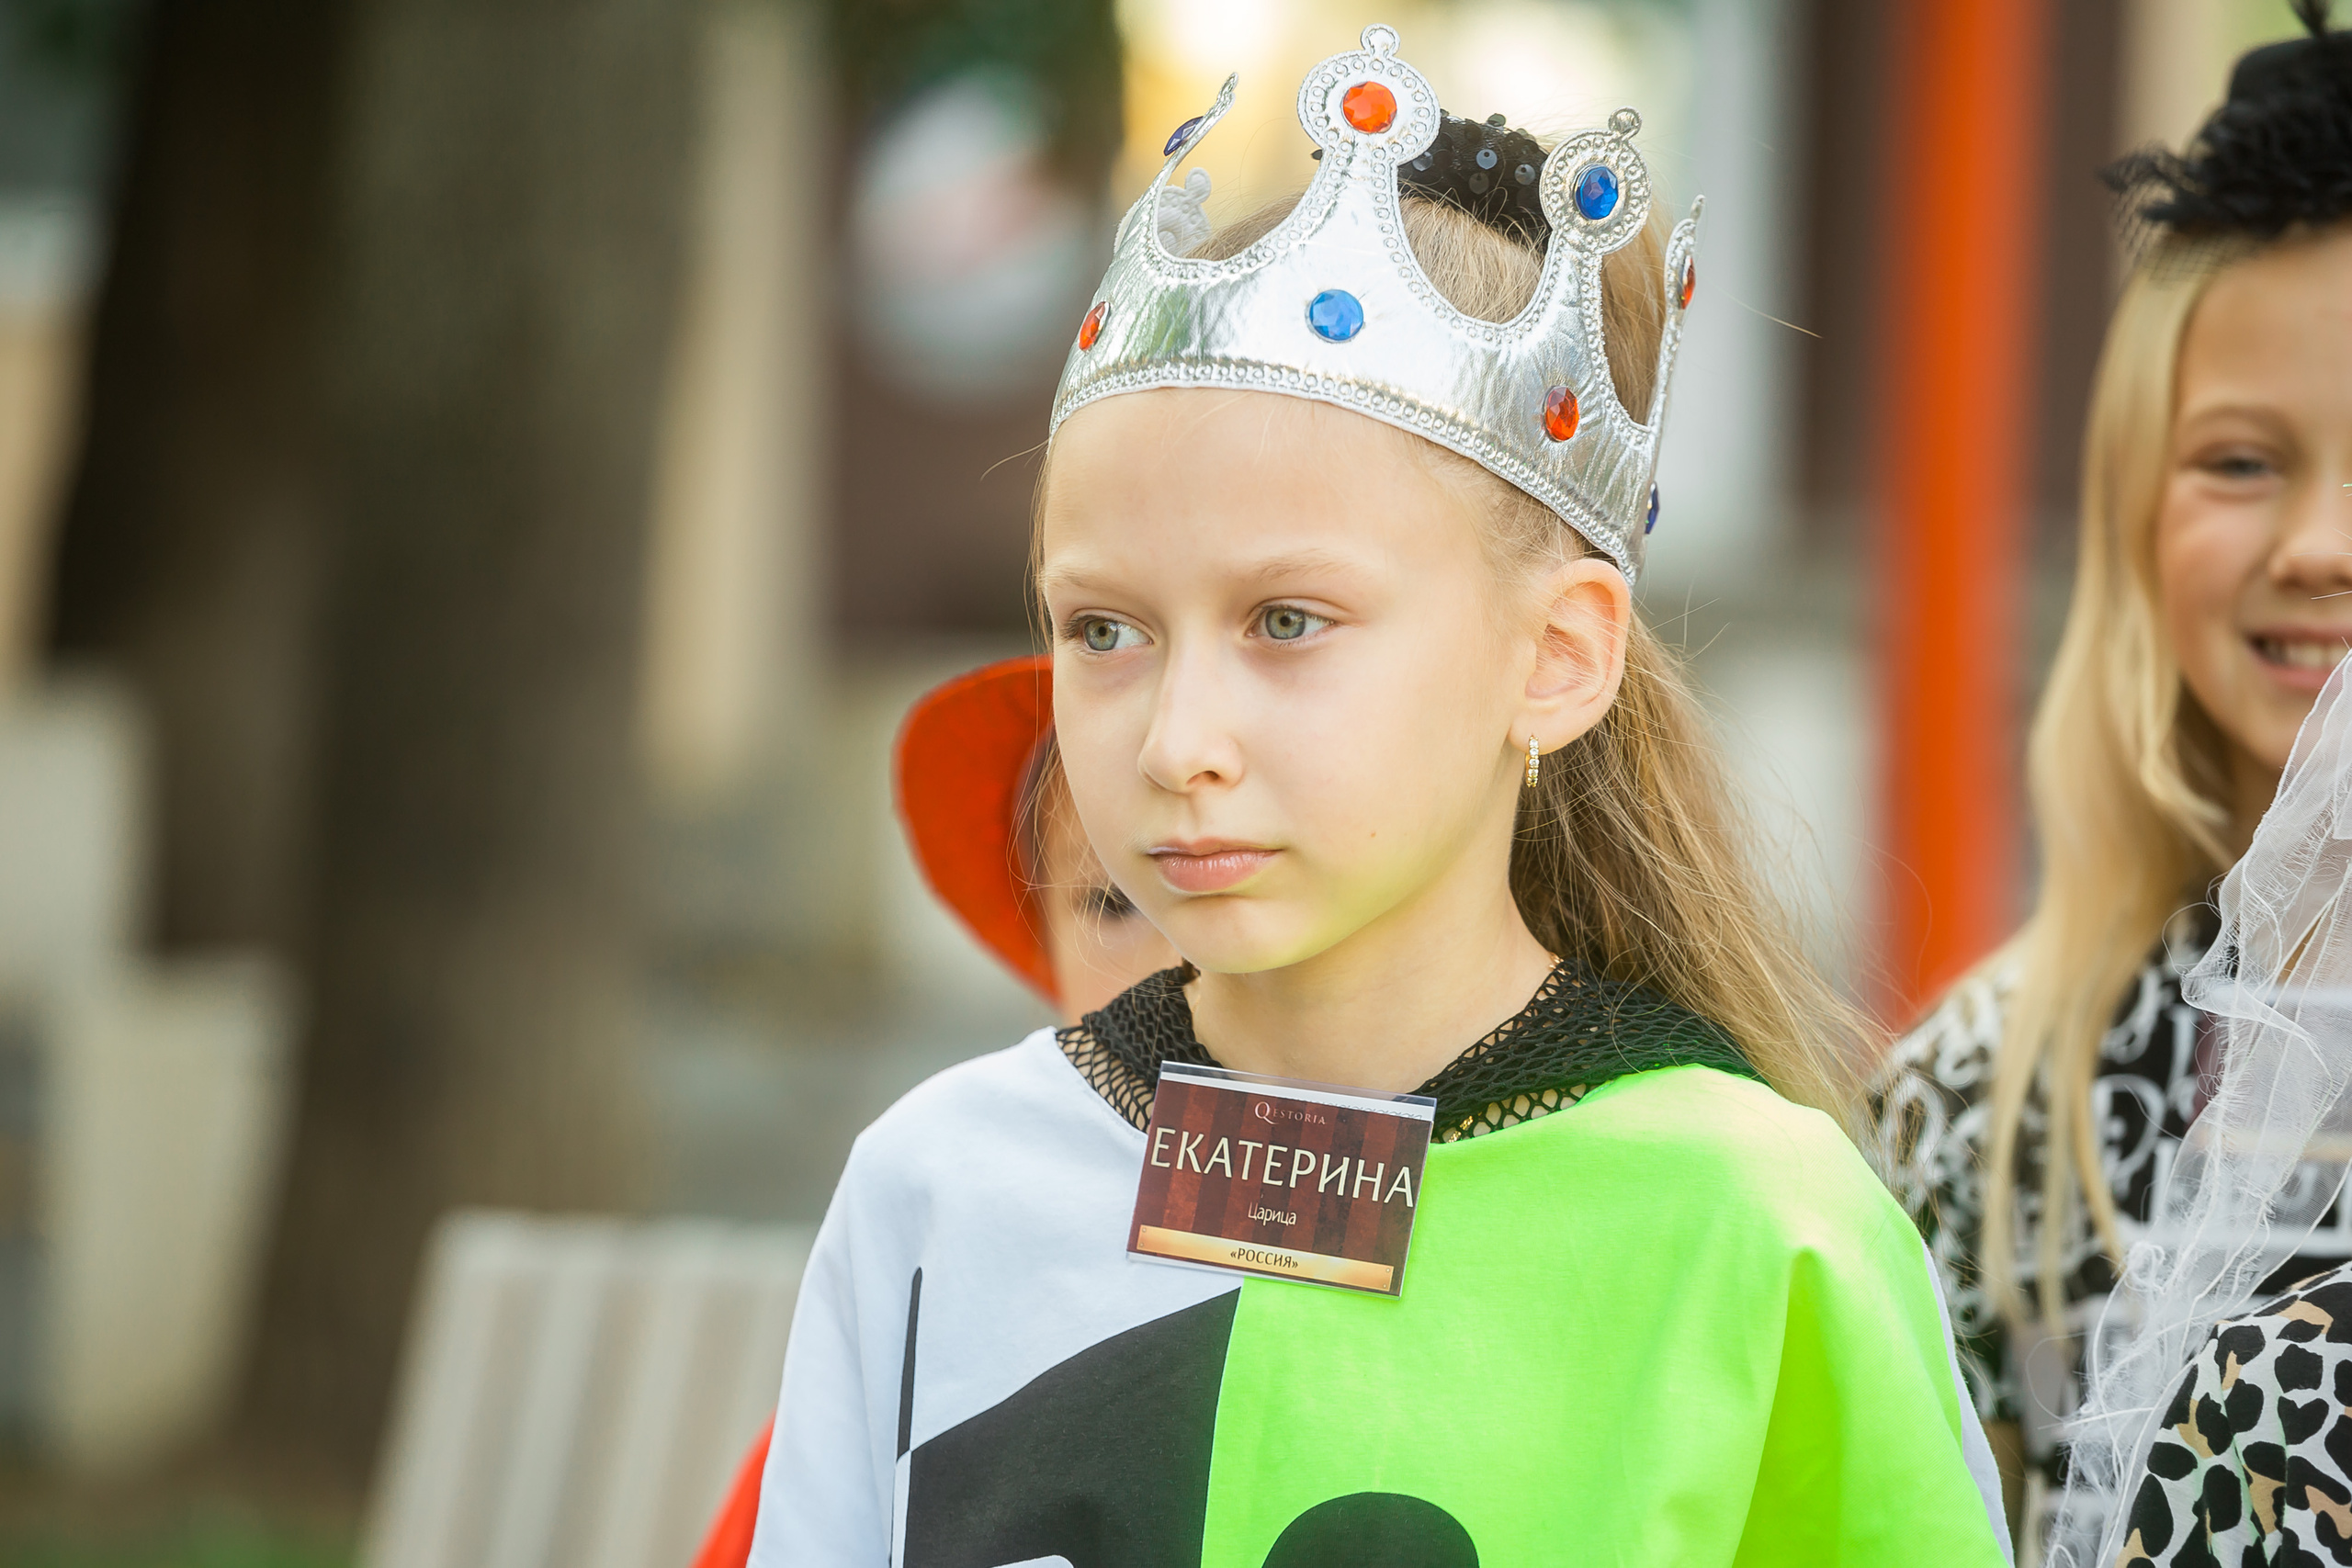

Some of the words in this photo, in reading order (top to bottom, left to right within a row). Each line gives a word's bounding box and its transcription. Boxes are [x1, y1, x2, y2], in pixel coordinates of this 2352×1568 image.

[1255, 1101, 1326, 1125] QESTORIA
[1150, 1127, 1414, 1208] ЕКАТЕРИНА
[1248, 1201, 1296, 1226] Царица
[1230, 1247, 1298, 1269] «РОССИЯ»
